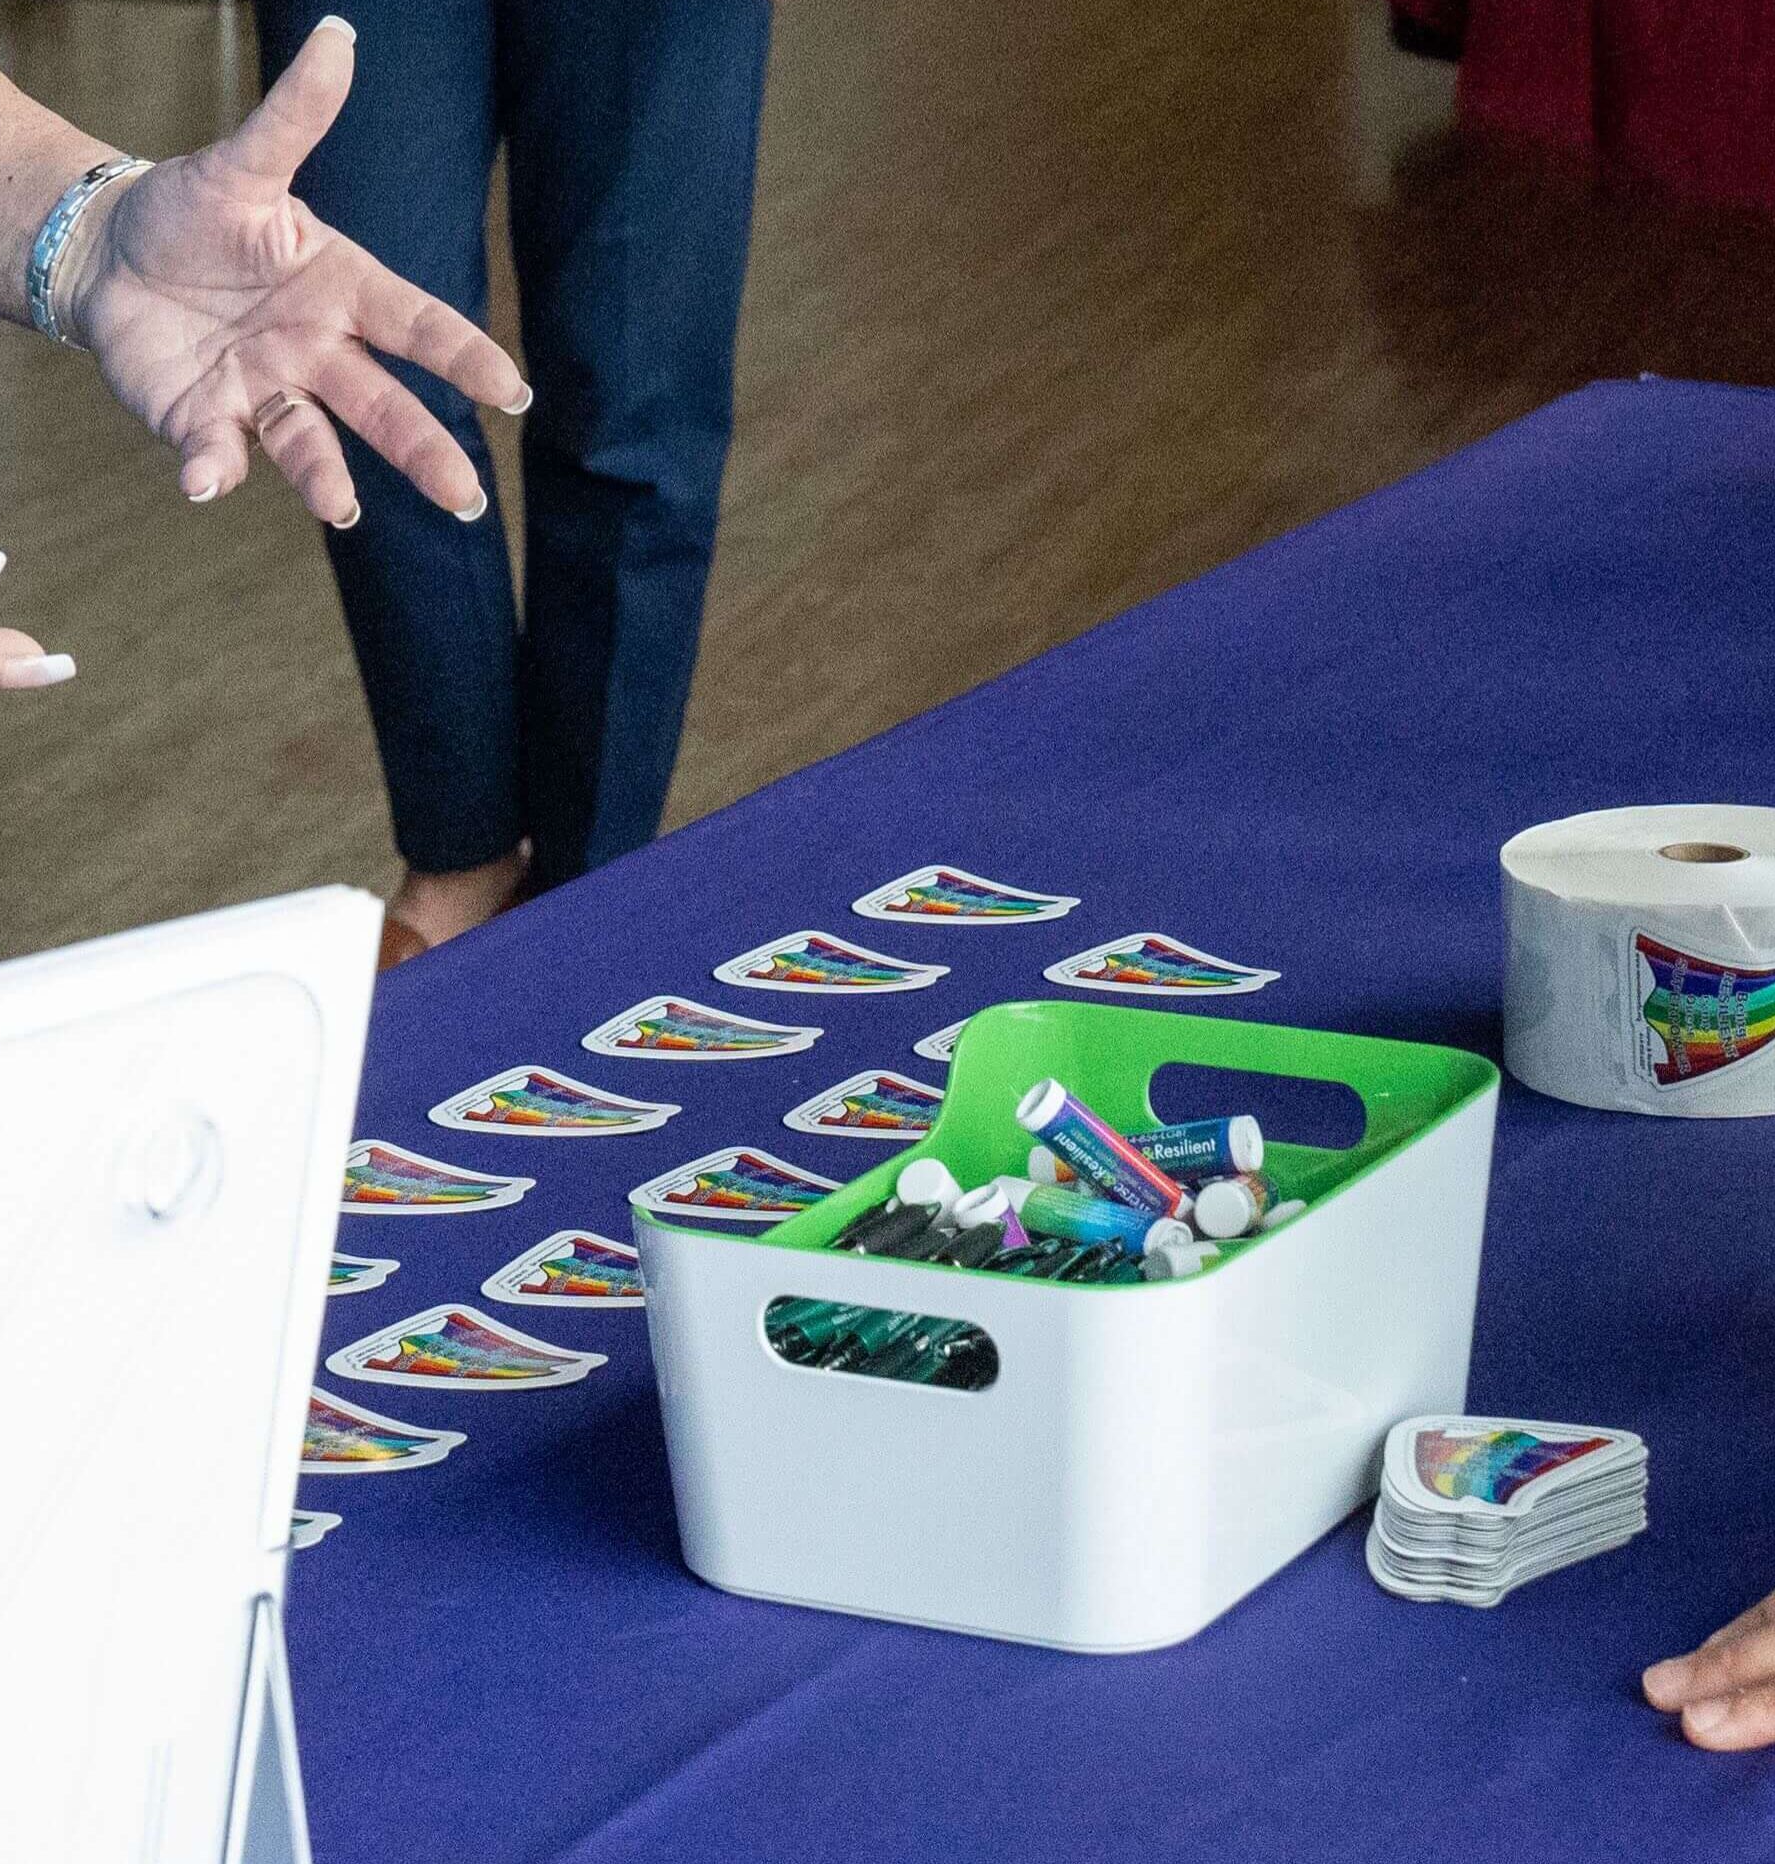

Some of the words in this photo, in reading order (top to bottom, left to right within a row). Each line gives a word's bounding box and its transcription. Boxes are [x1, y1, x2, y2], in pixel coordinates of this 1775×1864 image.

[1667, 958, 1692, 1075] SUPERPOWER
[1718, 971, 1739, 1058] RESILIENT
[1734, 991, 1749, 1038] Being
[1052, 1131, 1107, 1180] Resilient
[1154, 1137, 1218, 1160] Resilient
